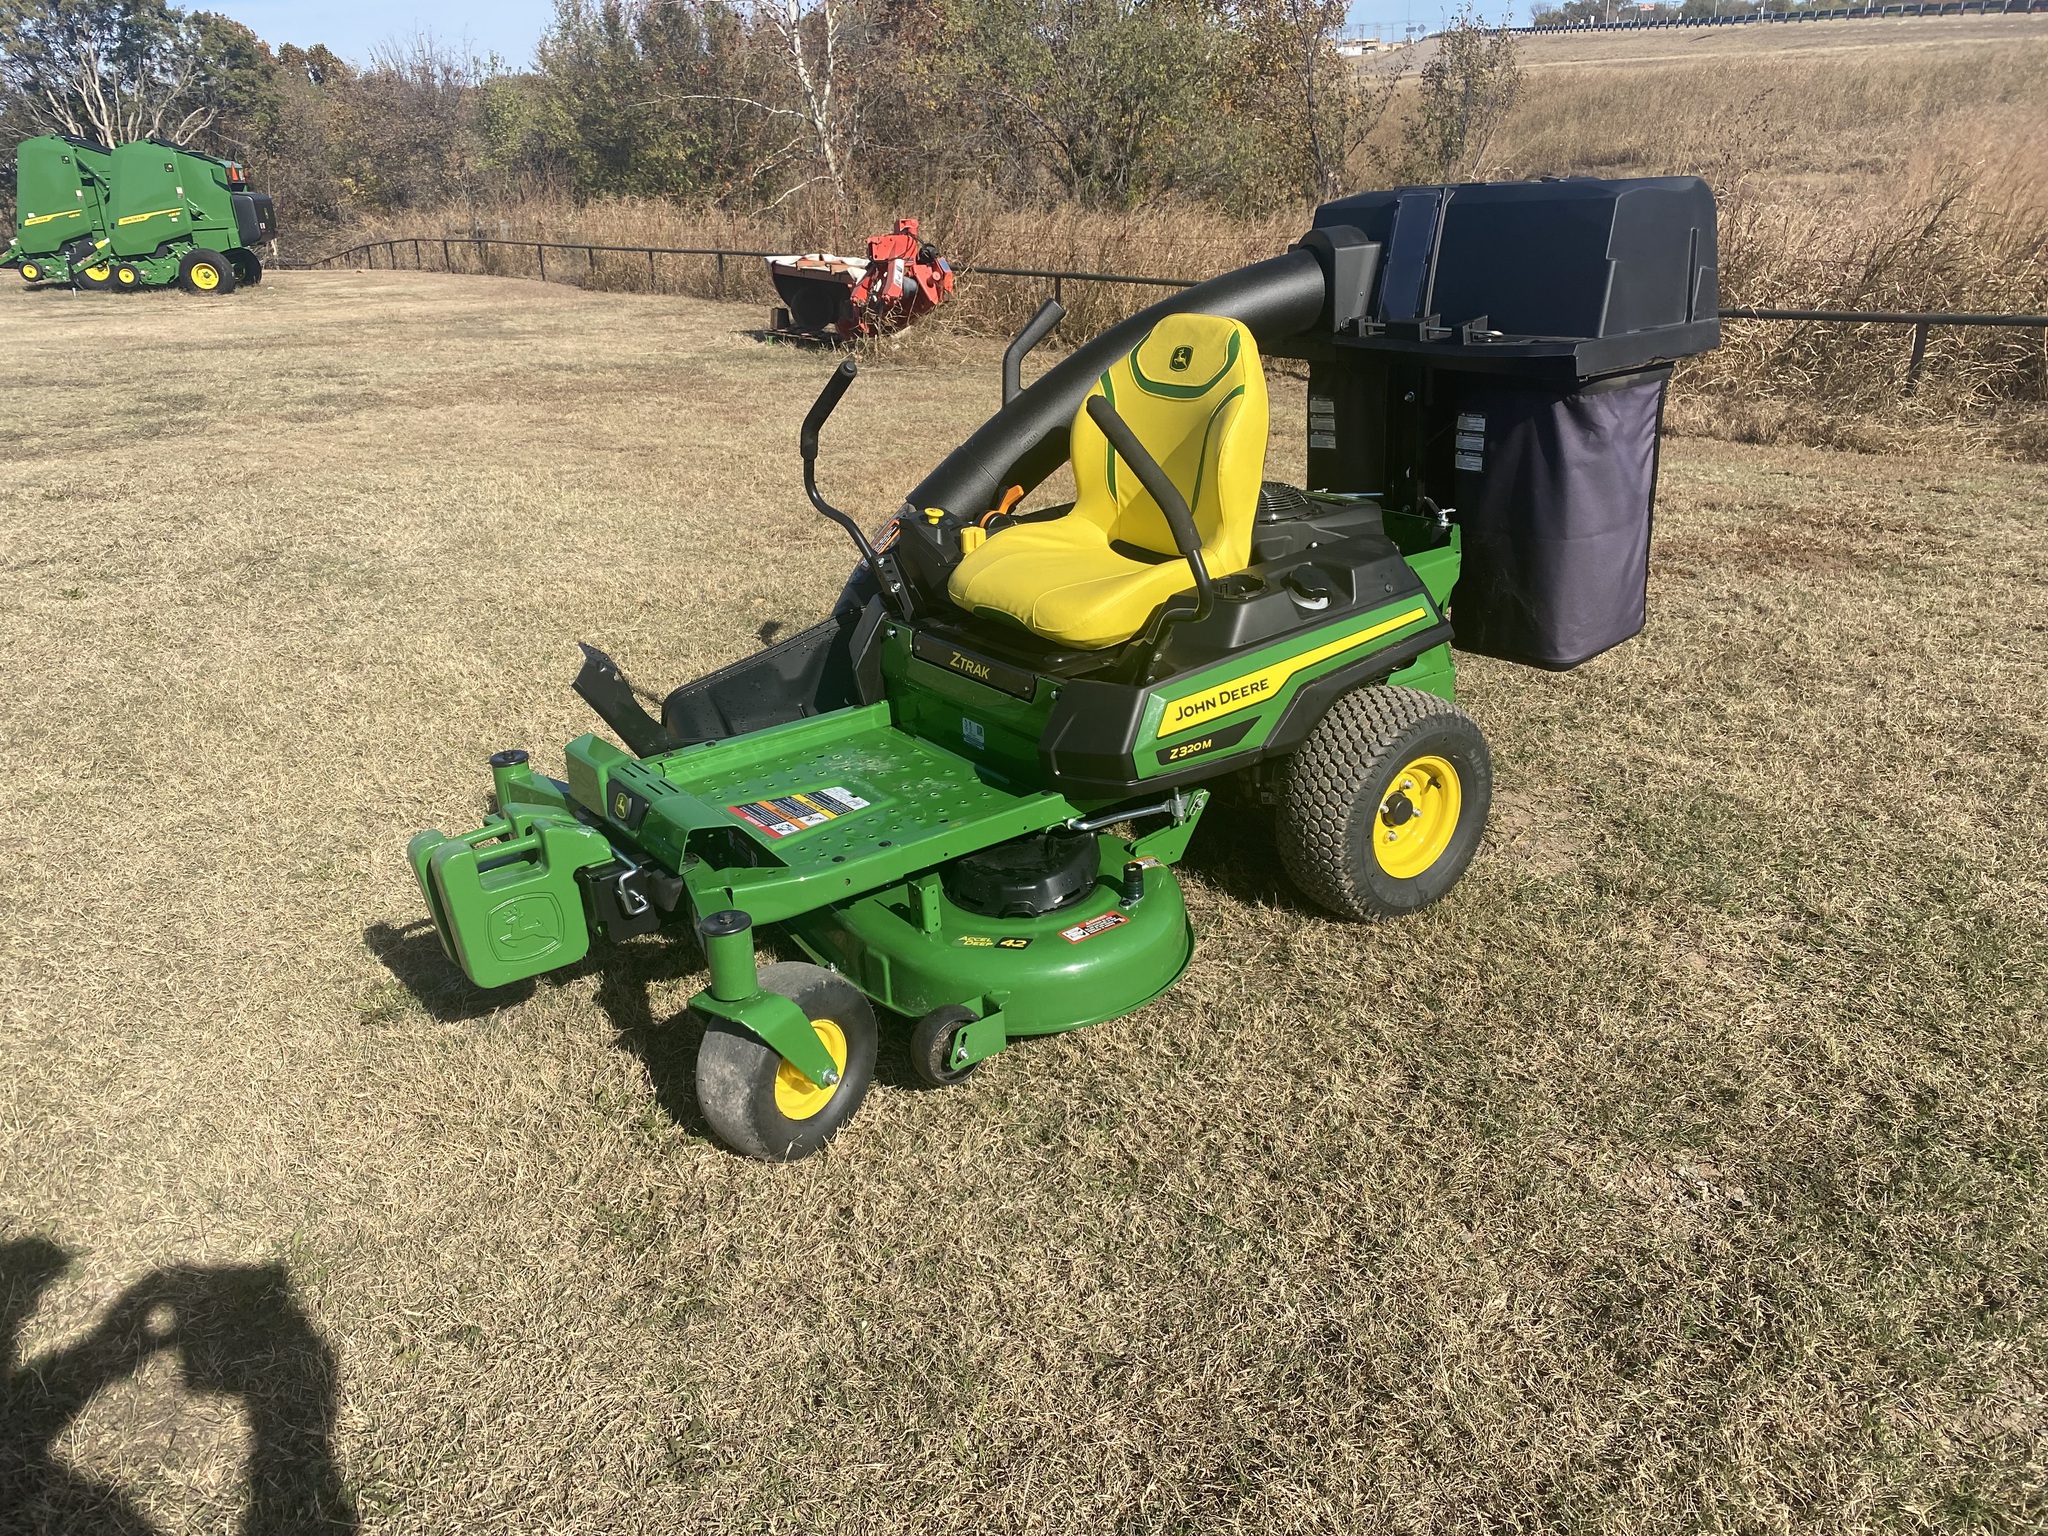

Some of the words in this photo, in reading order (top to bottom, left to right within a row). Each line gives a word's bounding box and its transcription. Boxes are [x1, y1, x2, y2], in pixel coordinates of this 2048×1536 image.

[949, 651, 991, 680] ZTRAK
[1175, 697, 1217, 722] JOHN
[1219, 678, 1270, 706] DEERE
[1169, 739, 1212, 760] Z320M
[958, 935, 992, 943] ACCEL
[1000, 939, 1028, 948] 42
